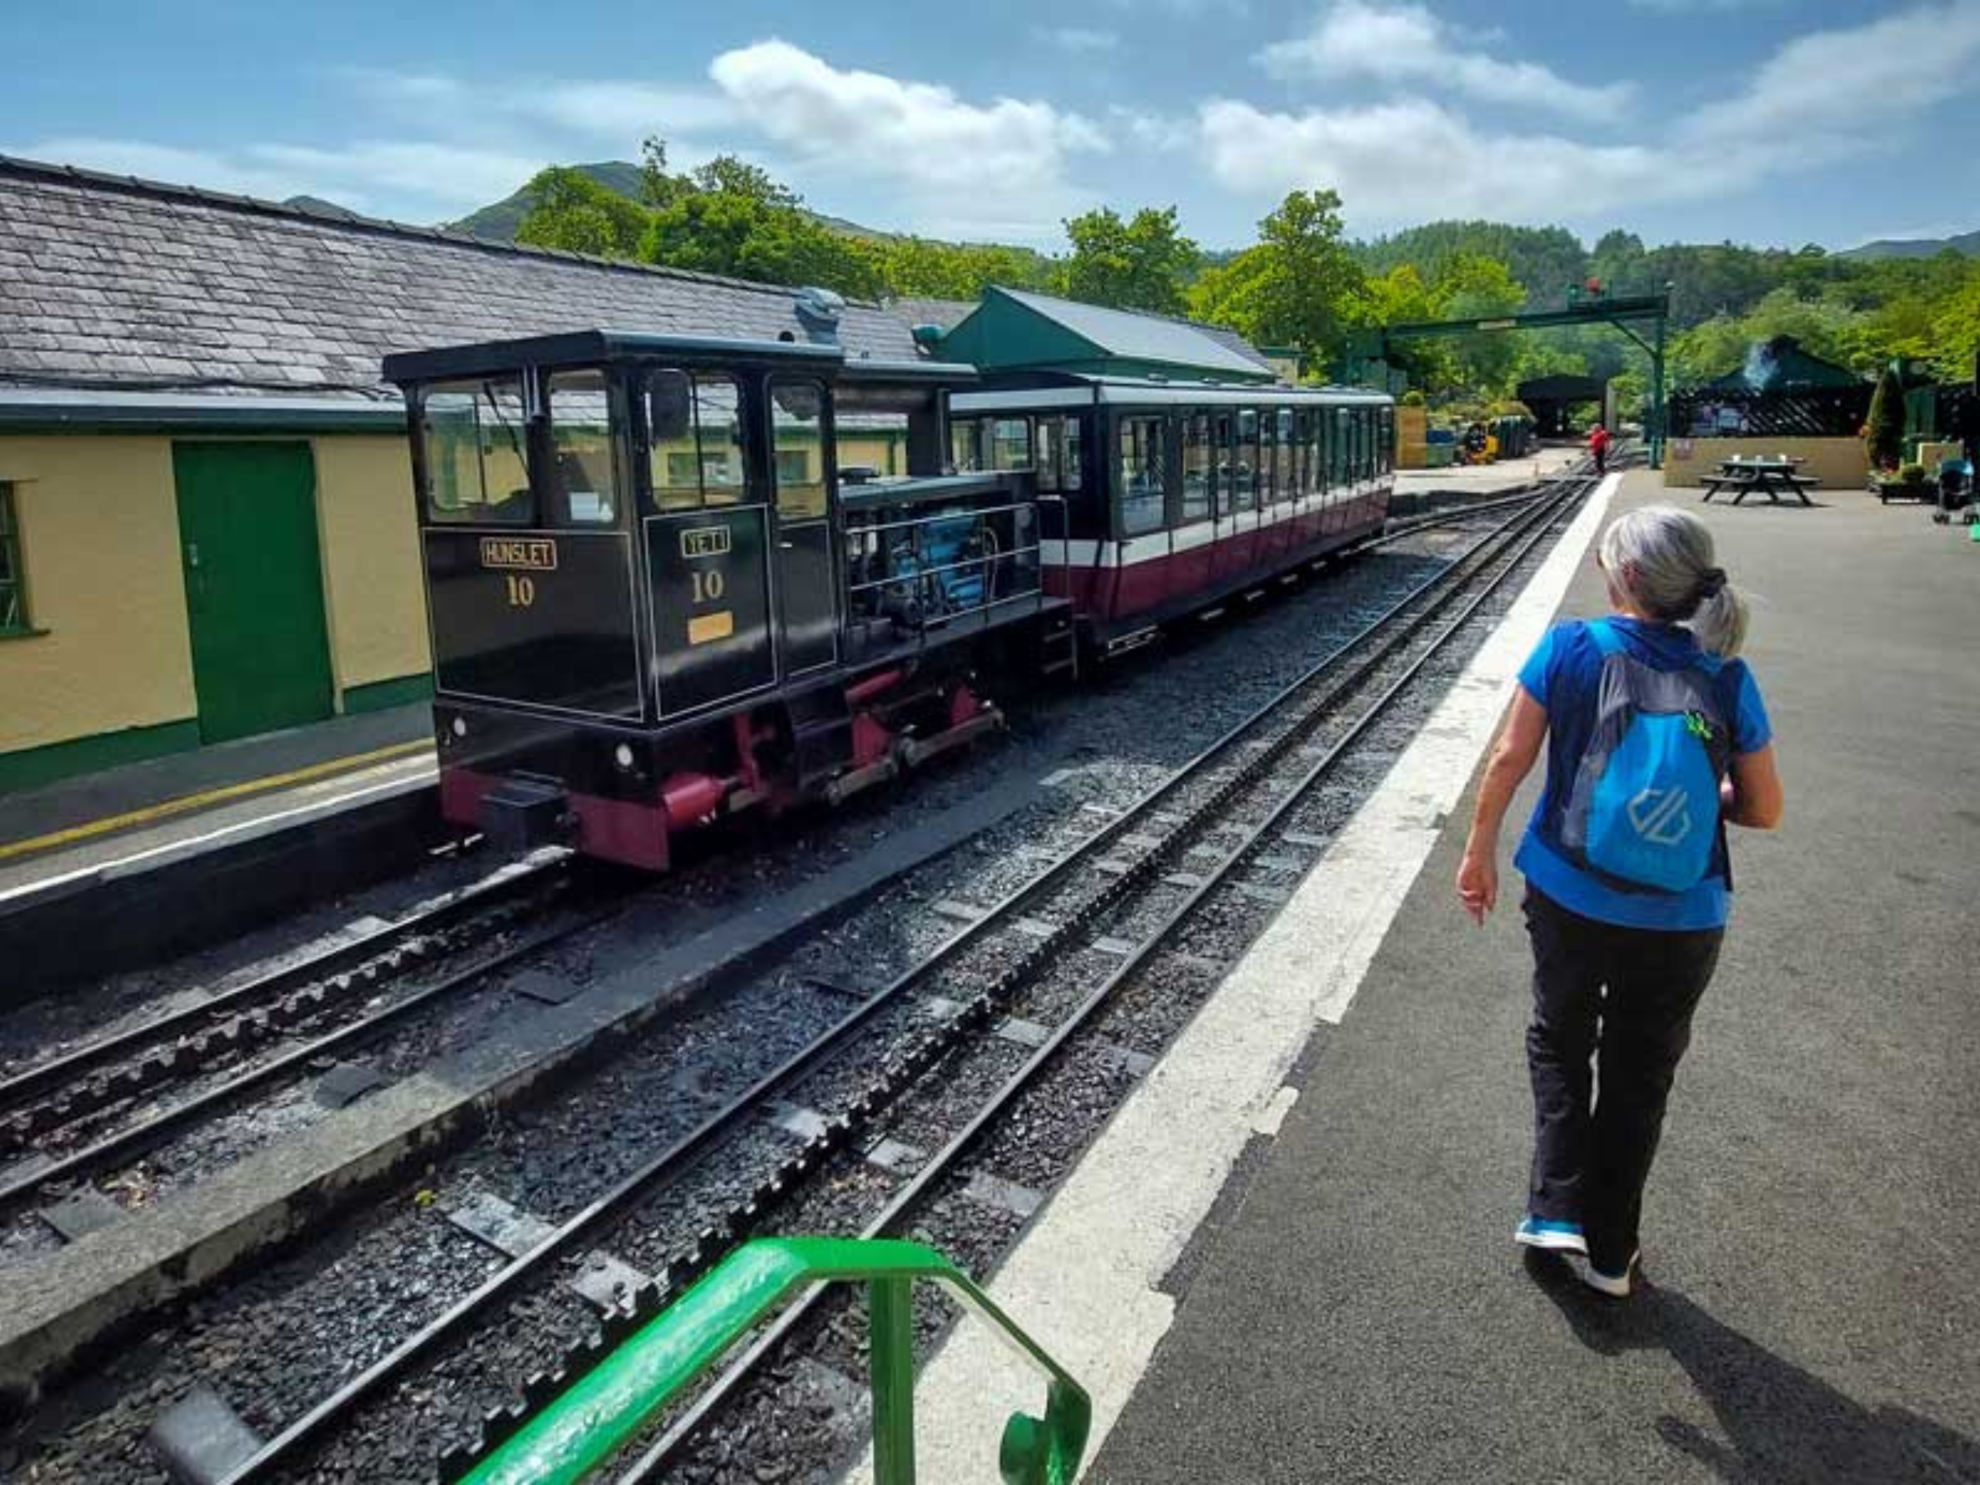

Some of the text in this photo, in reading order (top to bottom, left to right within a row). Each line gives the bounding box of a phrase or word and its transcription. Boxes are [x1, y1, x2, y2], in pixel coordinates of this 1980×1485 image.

[485, 542, 550, 566] HUNSLET
[507, 576, 534, 607] 10
[693, 571, 723, 603] 10
